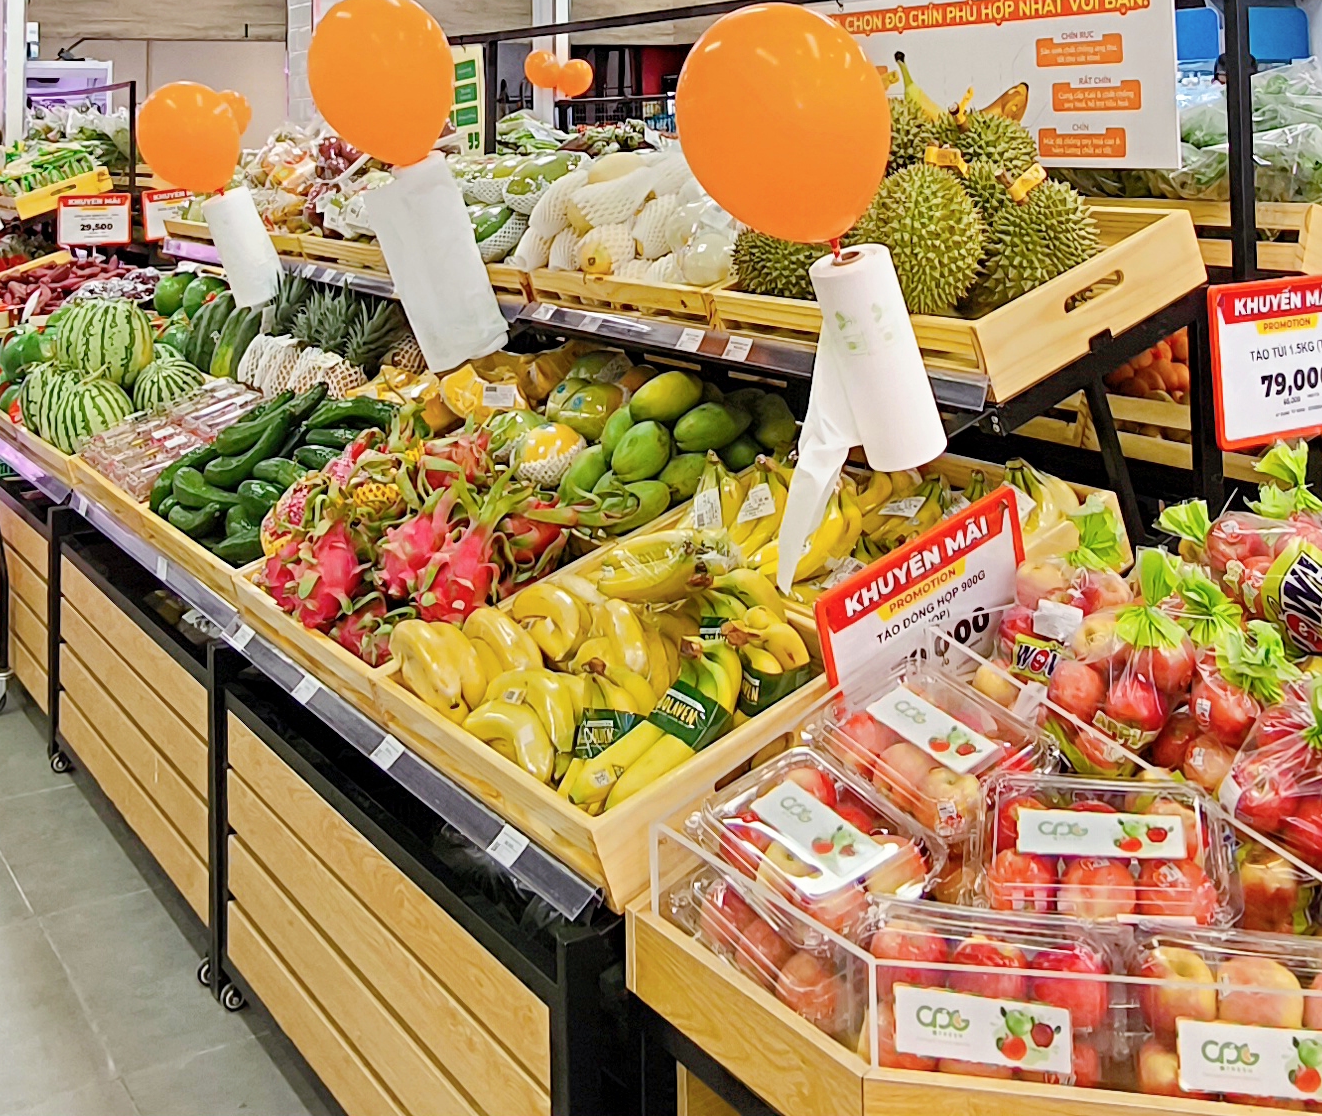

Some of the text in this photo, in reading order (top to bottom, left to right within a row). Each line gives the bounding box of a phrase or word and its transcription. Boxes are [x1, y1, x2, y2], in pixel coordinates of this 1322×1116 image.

[845, 14, 883, 36] CHỌN
[885, 7, 906, 34] ĐỘ
[908, 2, 944, 28] CHÍN
[1234, 286, 1302, 316] KHUYẾN
[1263, 317, 1311, 330] PROMOTION
[1289, 341, 1315, 355] 1.5KG
[944, 515, 989, 557] MÃI
[888, 566, 956, 614] PROMOTION
[961, 569, 986, 592] 900G
